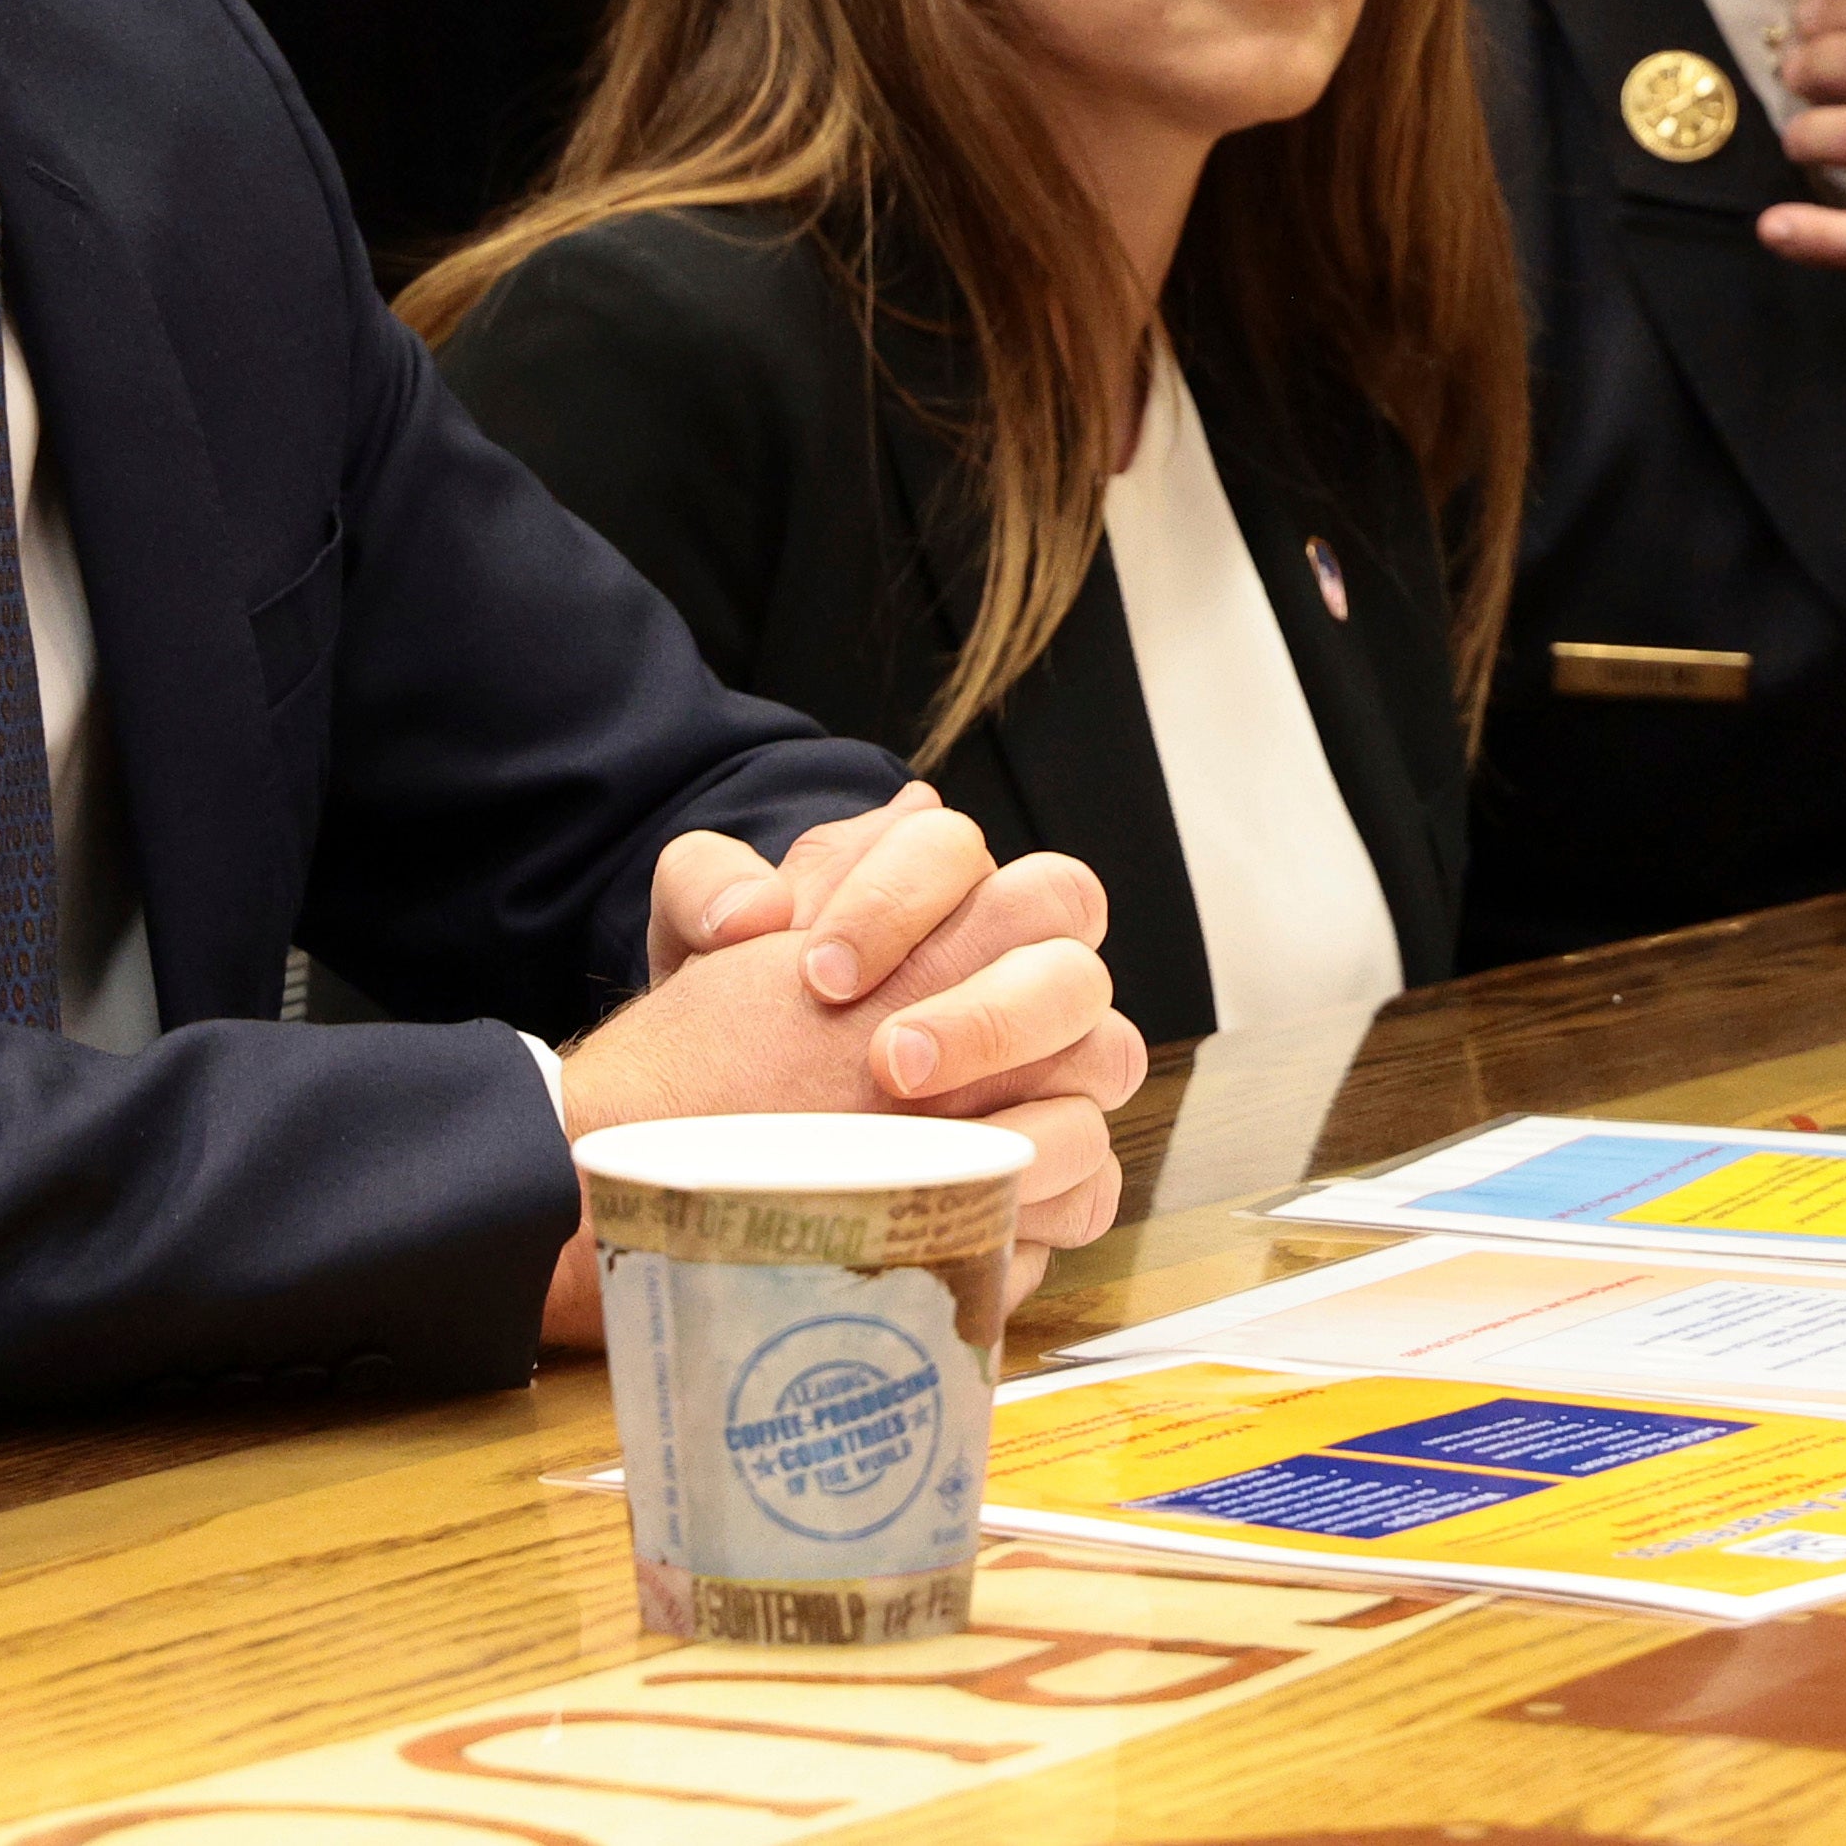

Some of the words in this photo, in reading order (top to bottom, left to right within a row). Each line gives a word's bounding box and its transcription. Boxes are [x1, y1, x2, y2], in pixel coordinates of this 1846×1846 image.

[725, 1361, 940, 1452] COFFEE-PRODUCING
[777, 1411, 908, 1473] COUNTRIES
[813, 1461, 850, 1490] THE
[856, 1436, 913, 1475] WORLD
